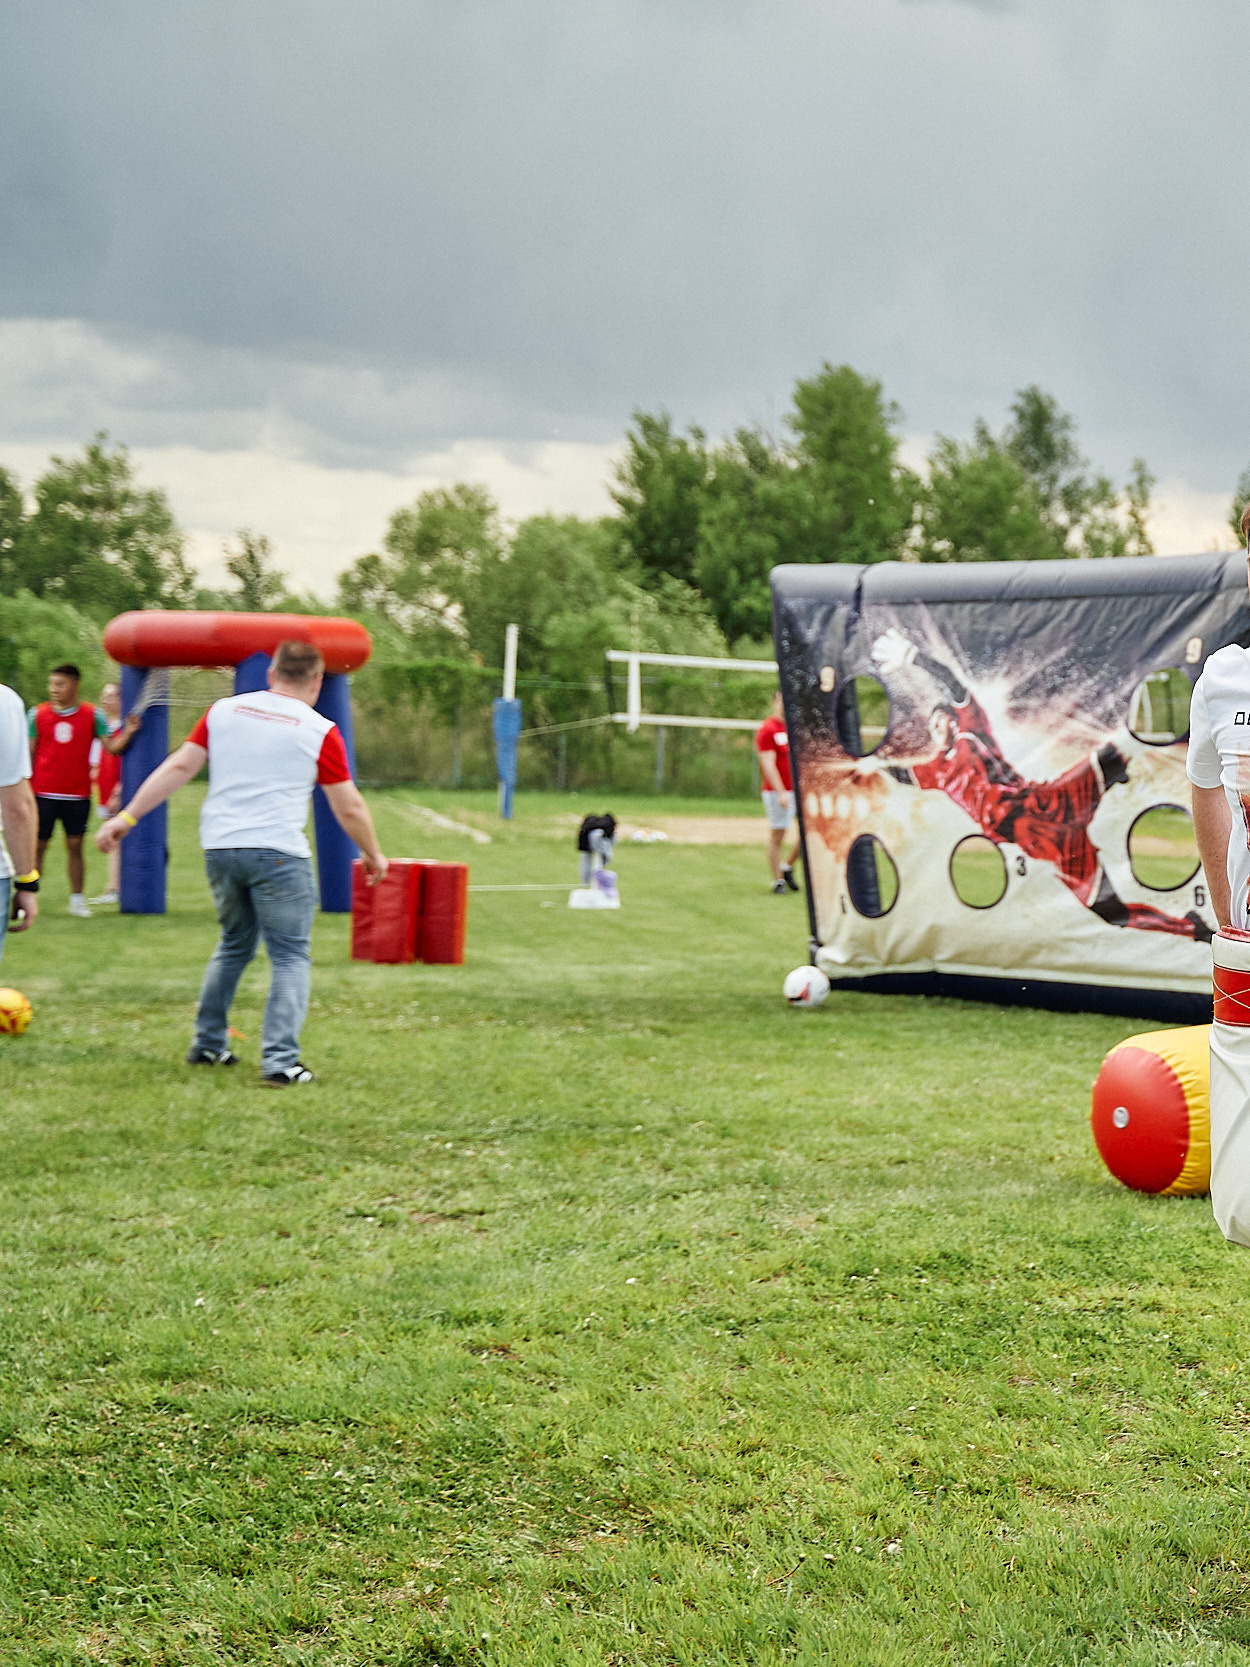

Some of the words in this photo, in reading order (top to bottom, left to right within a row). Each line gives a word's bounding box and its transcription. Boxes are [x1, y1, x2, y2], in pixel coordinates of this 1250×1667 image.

[1186, 637, 1203, 664] 9
[1016, 855, 1027, 877] 3
[1194, 885, 1205, 907] 6
